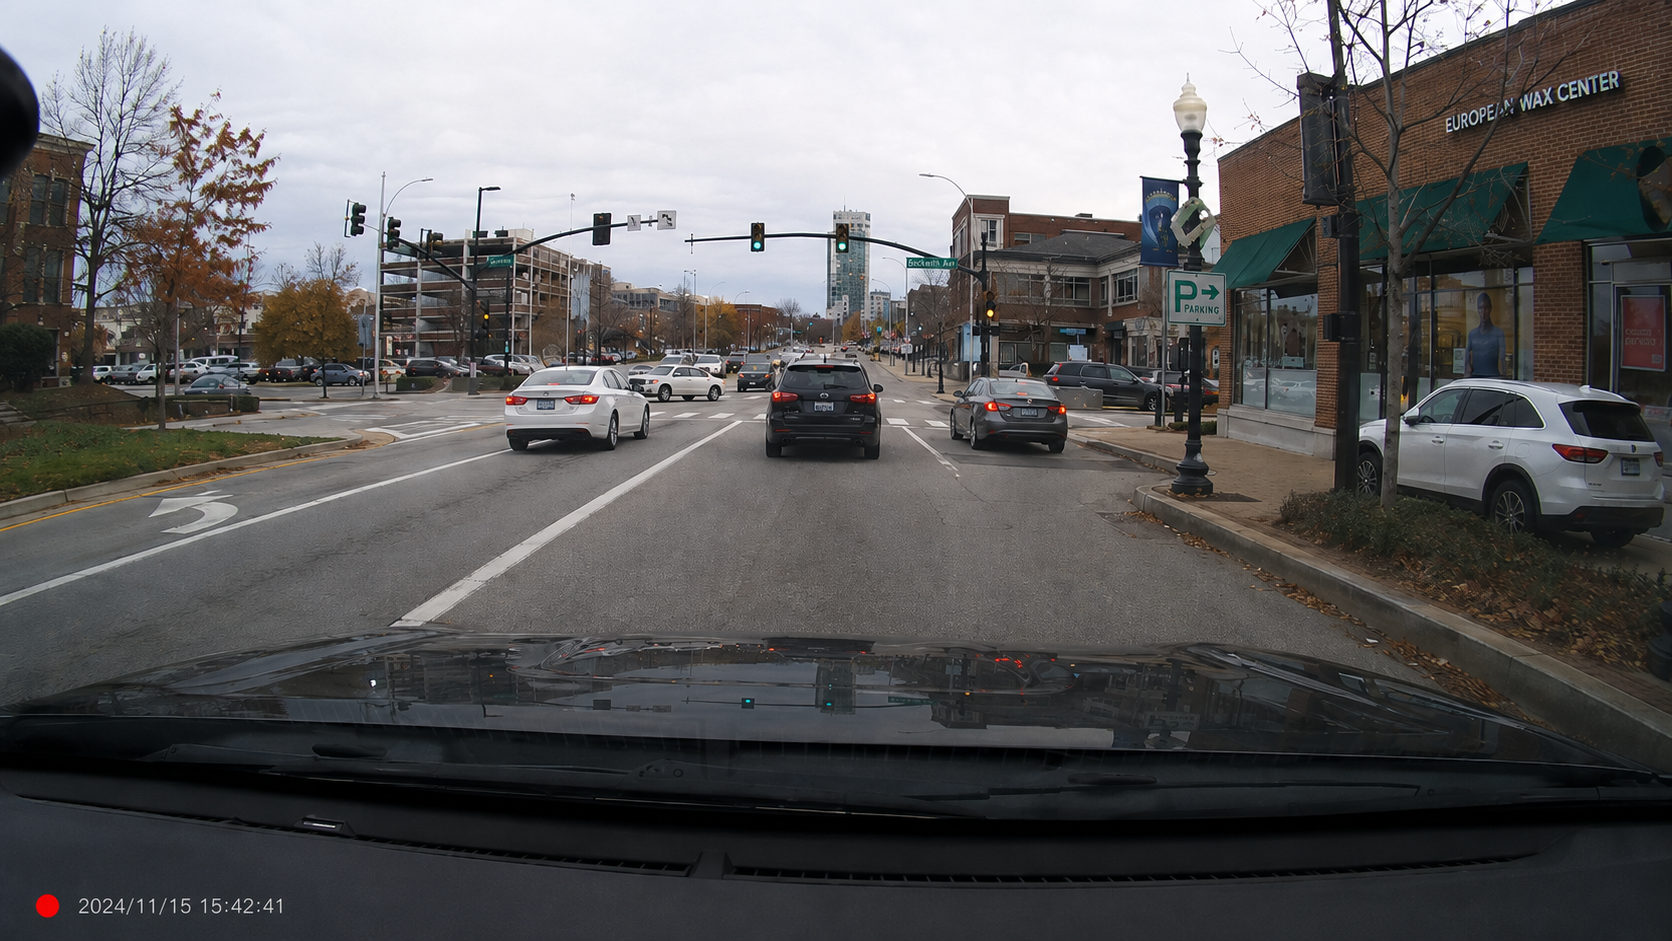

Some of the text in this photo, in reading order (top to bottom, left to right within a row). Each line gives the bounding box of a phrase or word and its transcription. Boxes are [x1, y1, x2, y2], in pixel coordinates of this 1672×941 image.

[1445, 70, 1620, 133] EUROPEAN WAX CENTER
[1175, 280, 1198, 312] P
[1184, 304, 1220, 315] PARKING
